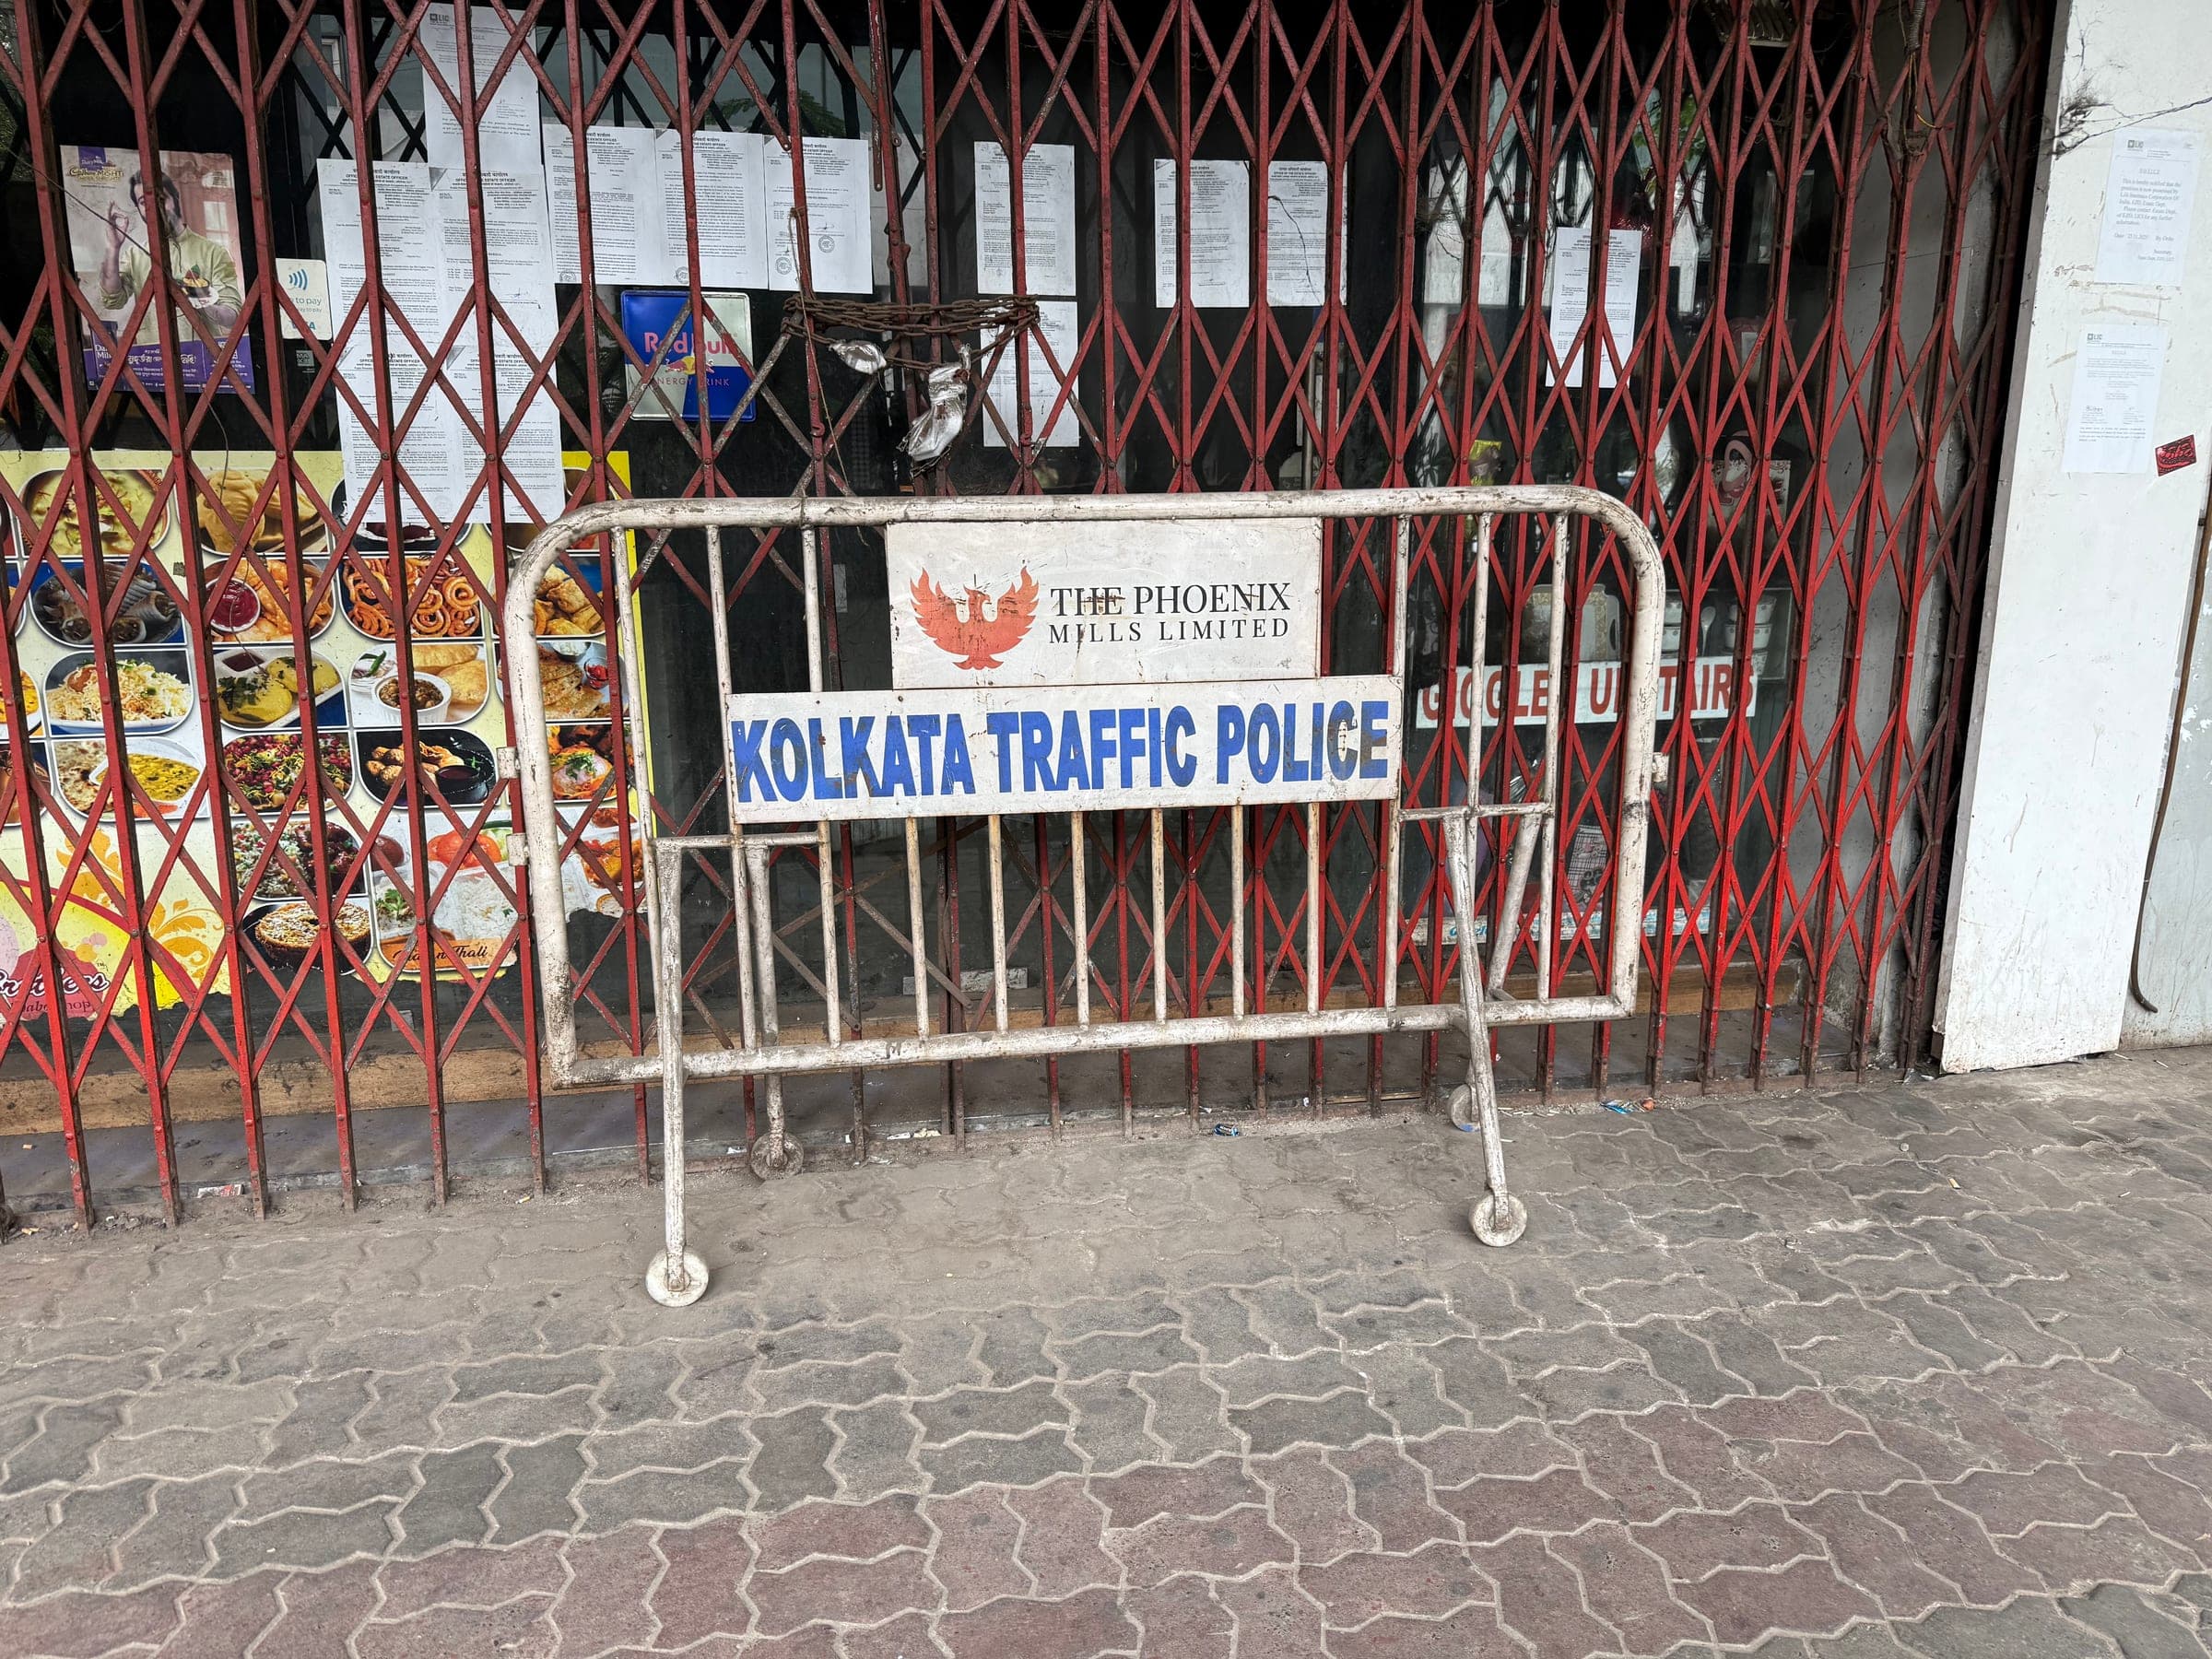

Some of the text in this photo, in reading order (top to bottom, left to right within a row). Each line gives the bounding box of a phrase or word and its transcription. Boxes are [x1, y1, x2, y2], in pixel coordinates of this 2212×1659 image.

[306, 298, 322, 307] pay
[644, 332, 688, 354] Rd
[1050, 582, 1291, 617] THE PHOENIX
[1049, 618, 1288, 644] MILLS LIMITED
[1422, 670, 1549, 721] GGGLE
[730, 700, 1389, 803] KOLKATA TRAFFIC POLICE
